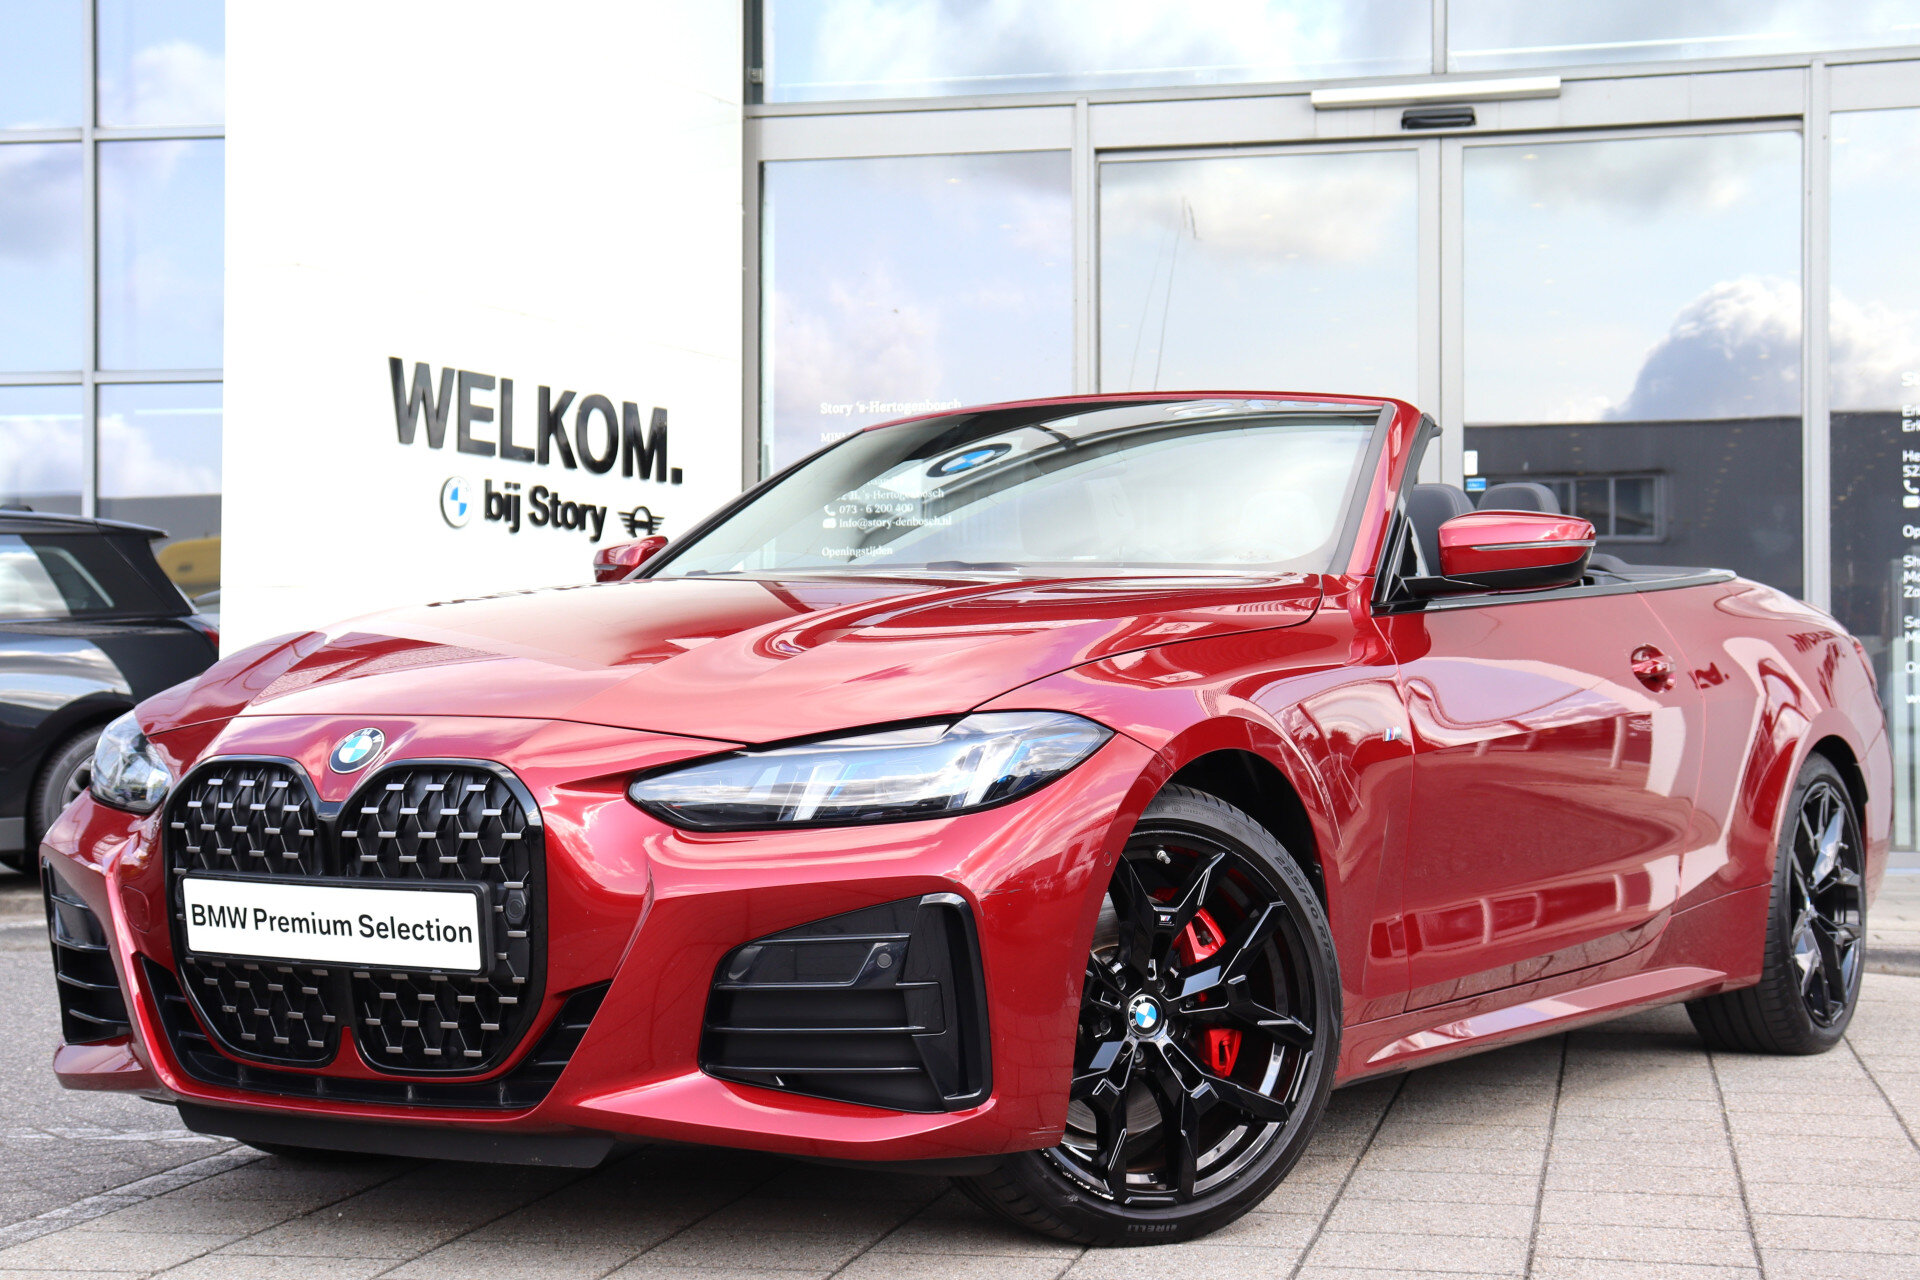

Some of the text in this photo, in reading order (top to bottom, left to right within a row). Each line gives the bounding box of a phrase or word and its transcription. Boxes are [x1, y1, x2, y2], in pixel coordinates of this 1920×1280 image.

[388, 356, 683, 485] WELKOM.
[820, 402, 853, 417] Story
[484, 478, 607, 543] bij Story
[839, 504, 857, 514] 073
[866, 504, 873, 513] 6
[874, 503, 893, 513] 200
[895, 503, 914, 512] 400
[821, 545, 893, 558] Openingstijden
[1274, 855, 1319, 920] 225/40
[191, 904, 473, 943] BMW Premium Selection
